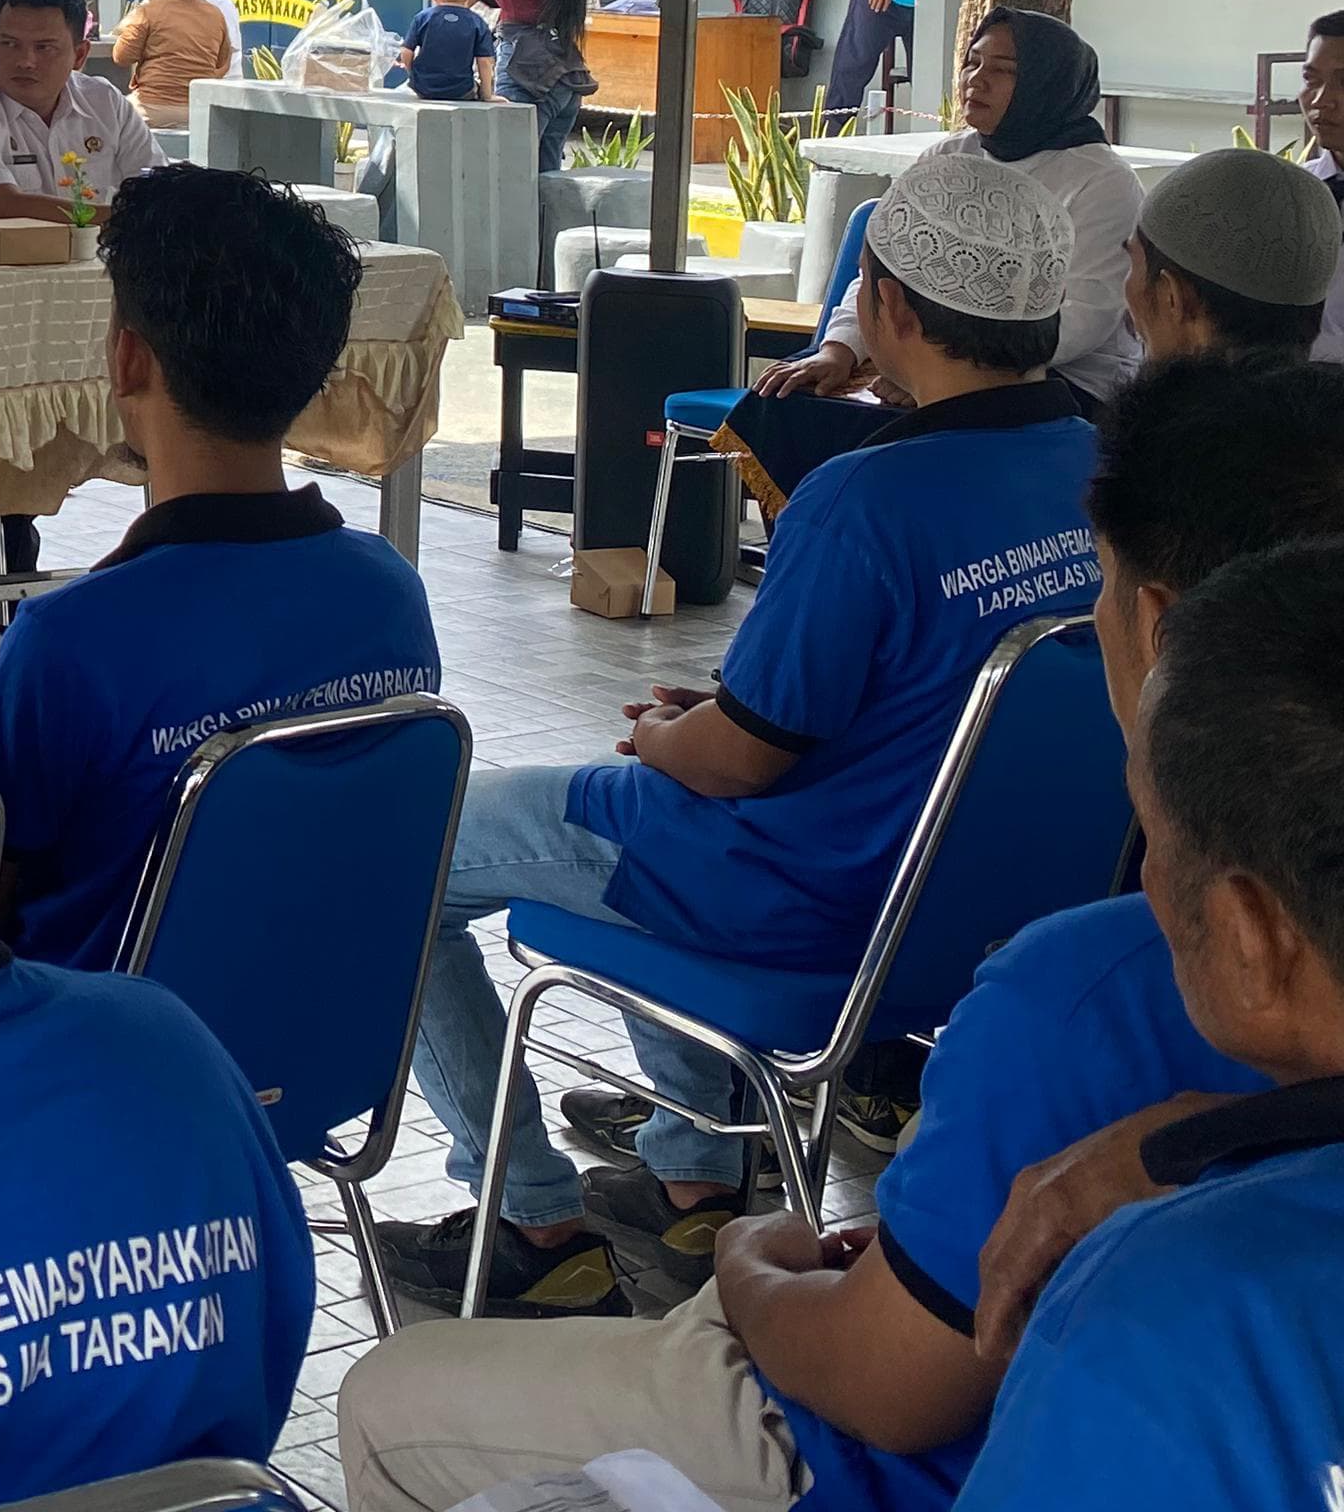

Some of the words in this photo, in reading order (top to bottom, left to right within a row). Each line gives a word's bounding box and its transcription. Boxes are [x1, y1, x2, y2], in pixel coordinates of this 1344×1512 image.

[939, 554, 1010, 600] WARGA
[1005, 535, 1063, 577] BINAAN
[977, 582, 1036, 618] LAPAS
[1033, 563, 1086, 600] KELAS
[151, 712, 231, 755] WARGA
[59, 1291, 225, 1374] TARAKAN
